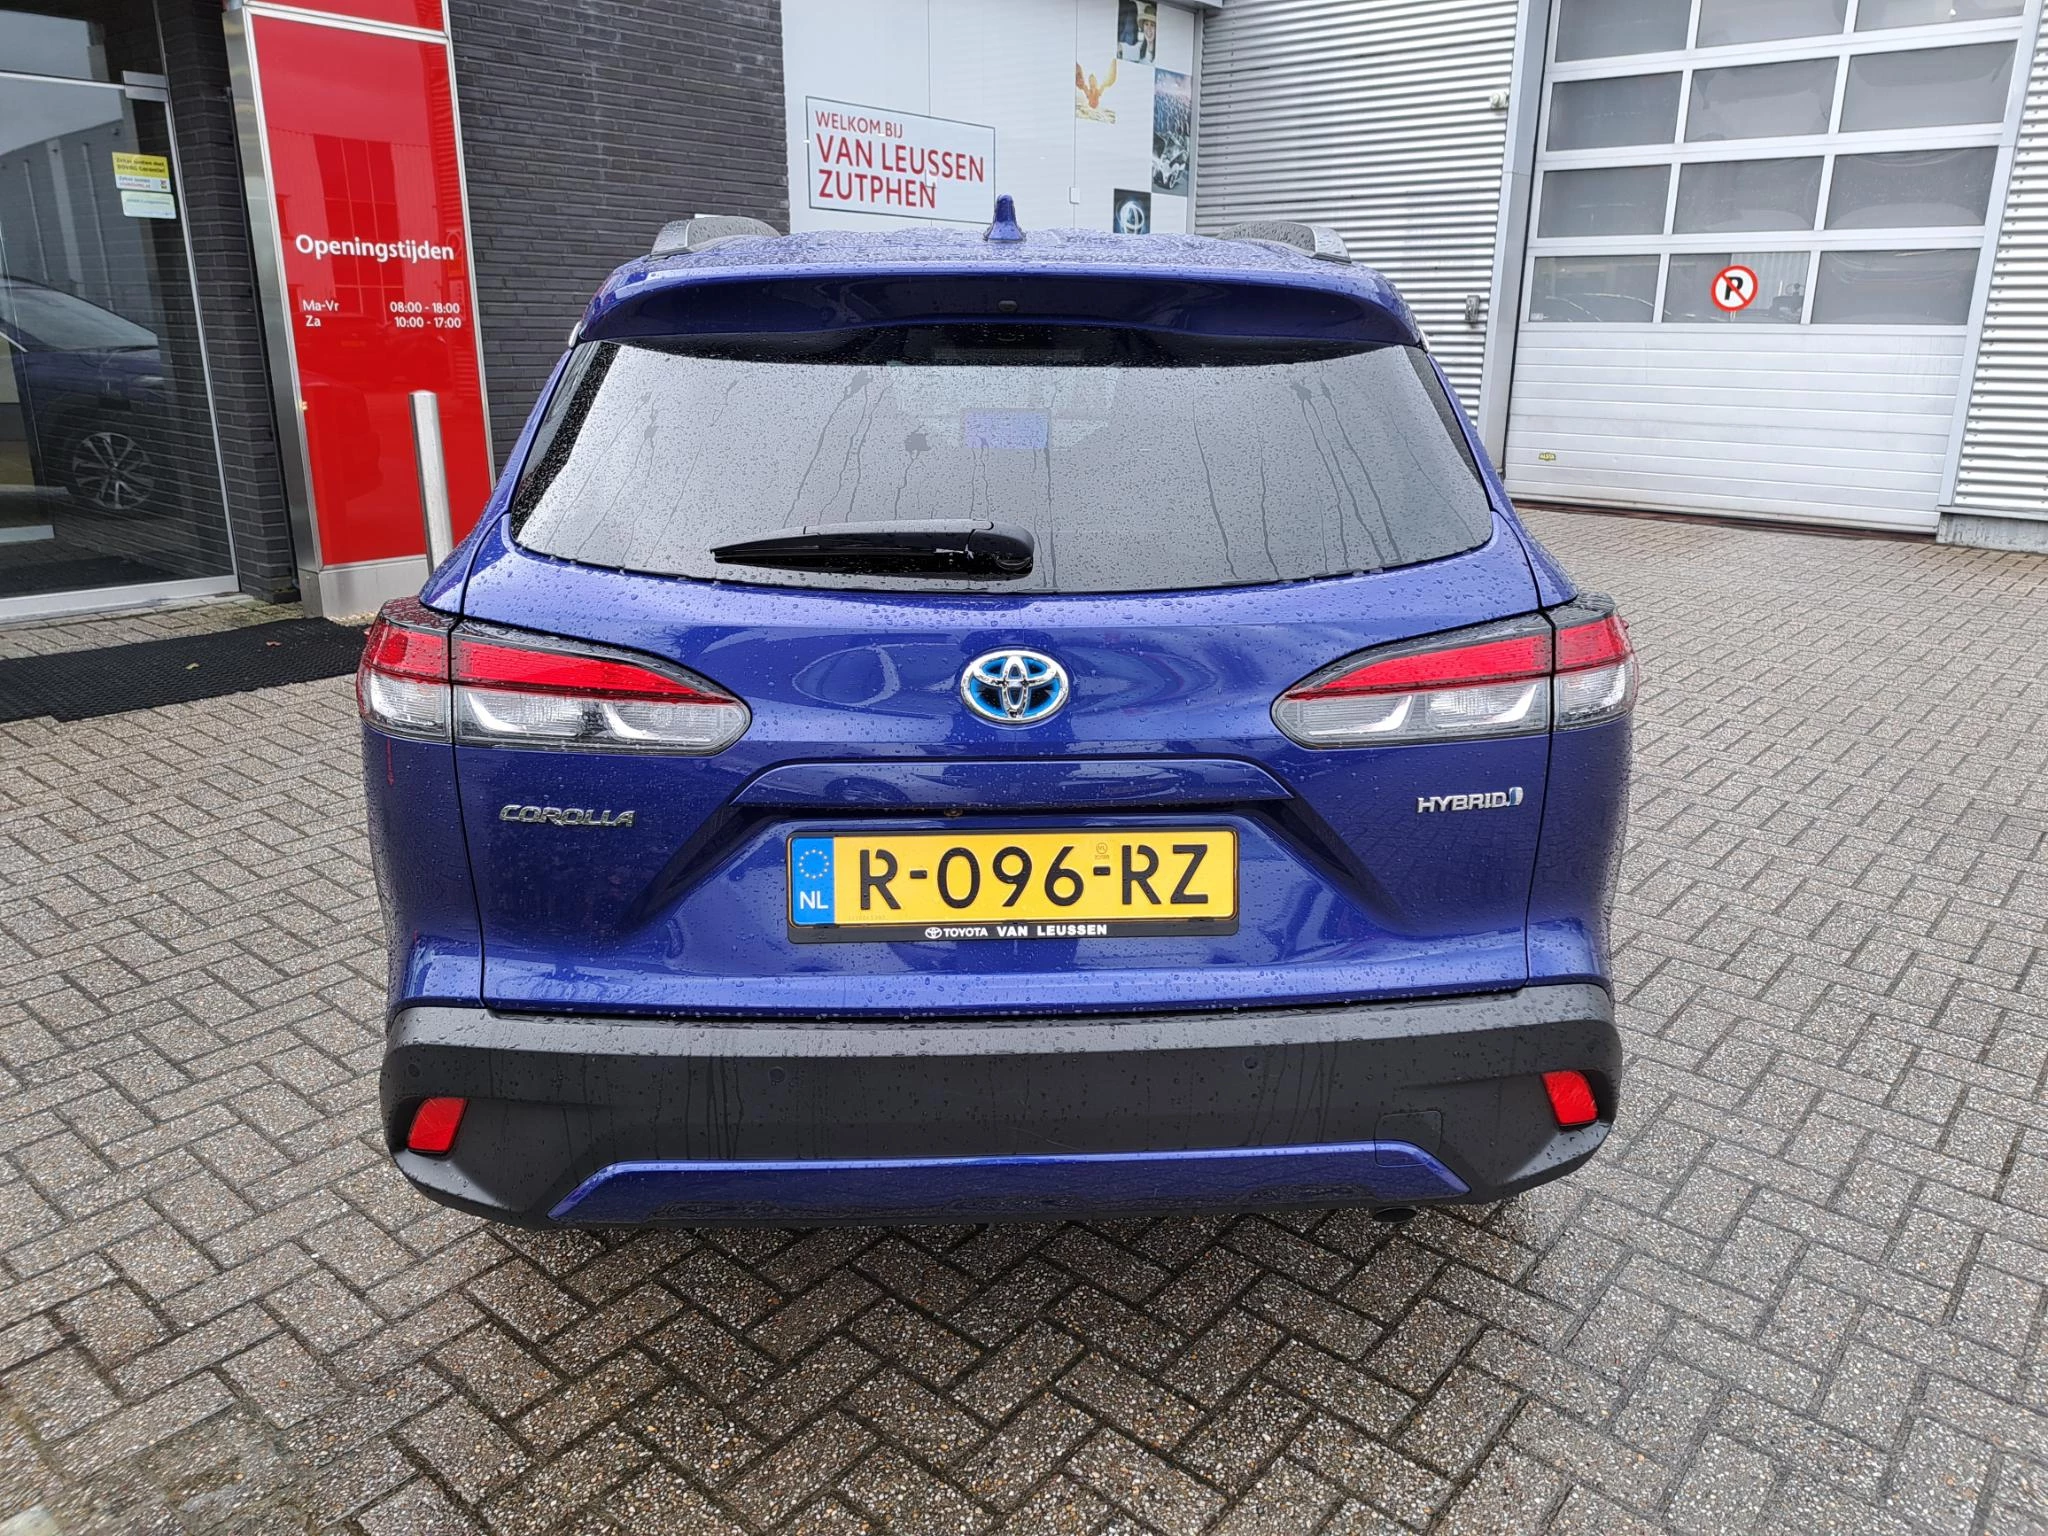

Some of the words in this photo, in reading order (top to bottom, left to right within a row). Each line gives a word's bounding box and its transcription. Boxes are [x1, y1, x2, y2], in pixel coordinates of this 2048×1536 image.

[815, 110, 881, 135] WELKOM
[885, 121, 903, 138] BIJ
[816, 133, 873, 169] VAN
[882, 142, 984, 183] LEUSSEN
[818, 168, 936, 209] ZUTPHEN
[295, 234, 455, 264] Openingstijden
[302, 299, 339, 312] Ma-Vr
[389, 301, 422, 313] 08:00
[432, 302, 460, 314] 18:00
[305, 315, 322, 327] Za
[394, 316, 424, 328] 10:00
[434, 317, 462, 328] 17:00
[1417, 791, 1508, 813] HYBRID
[499, 804, 636, 827] COROLLA
[859, 844, 1209, 911] R-096-RZ
[799, 891, 829, 909] NL
[943, 927, 988, 938] TOYOTA
[996, 926, 1028, 937] VAN
[1037, 924, 1107, 937] LEUSSEN
